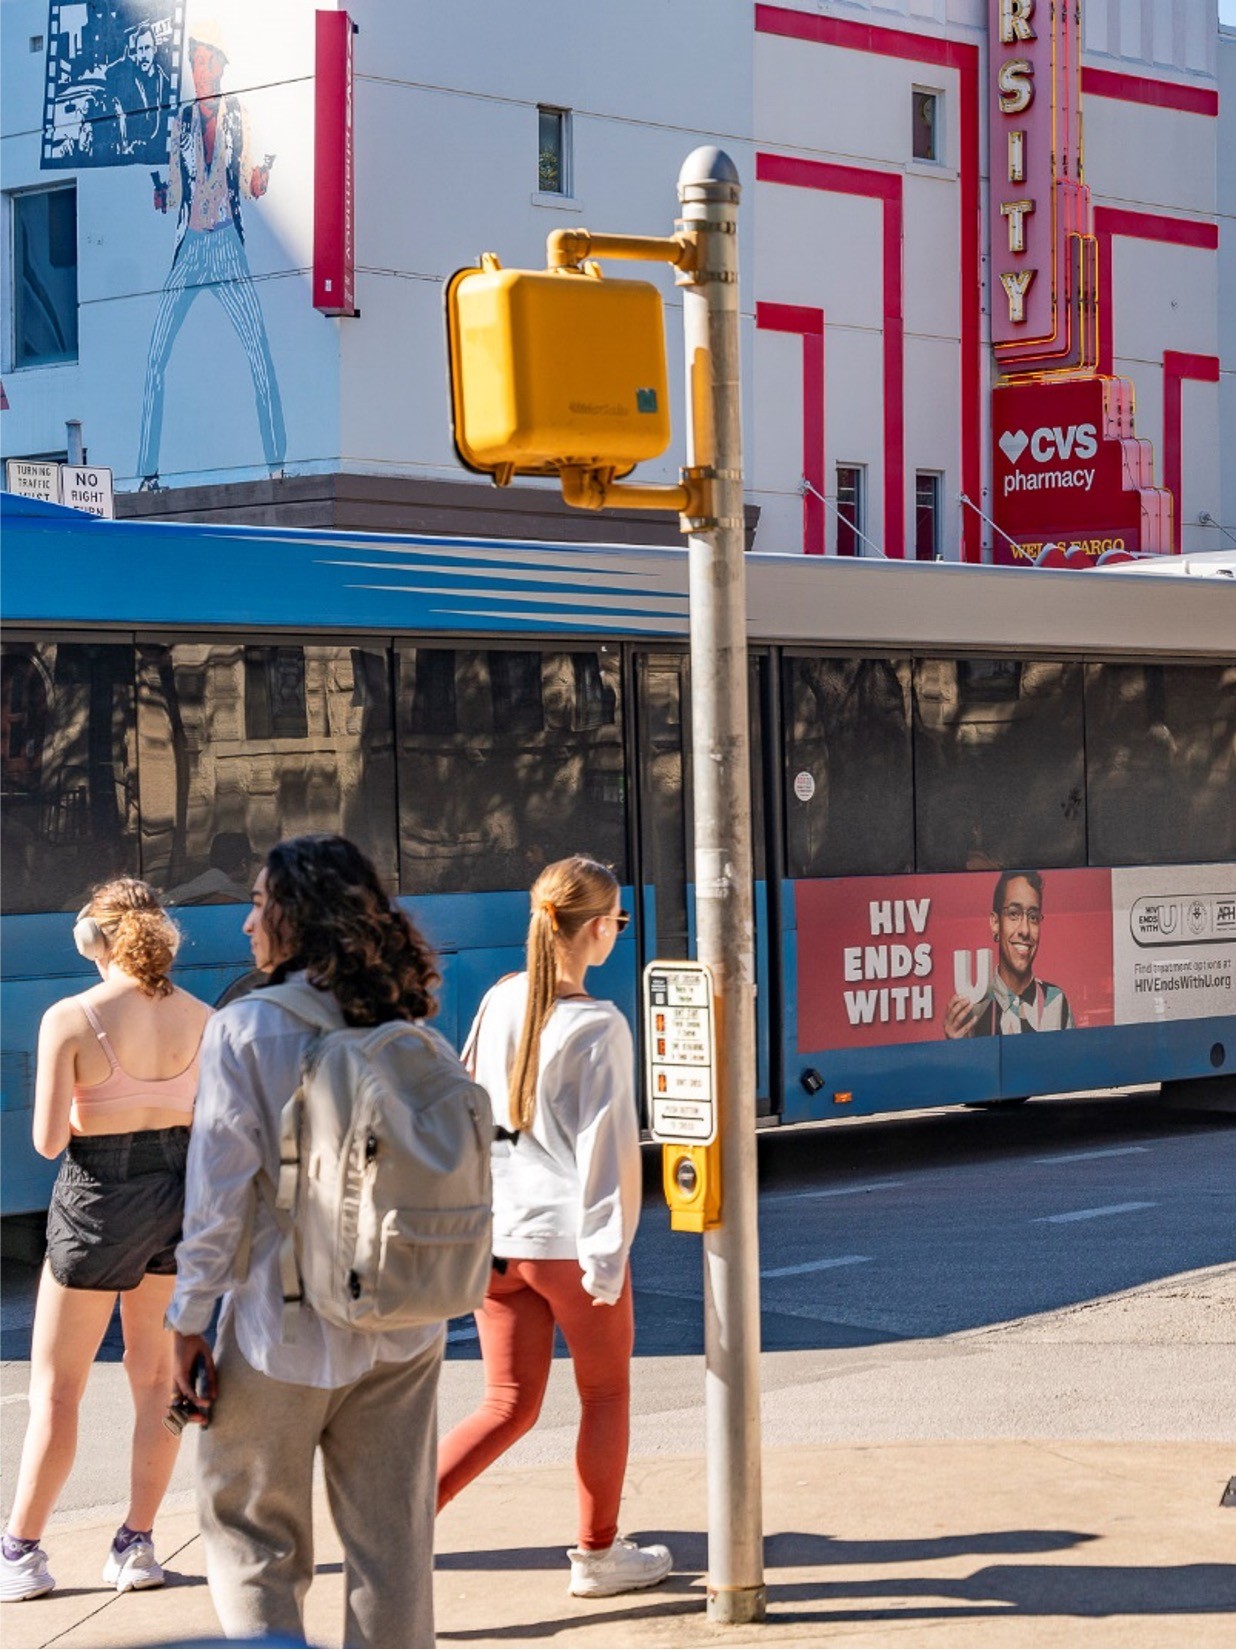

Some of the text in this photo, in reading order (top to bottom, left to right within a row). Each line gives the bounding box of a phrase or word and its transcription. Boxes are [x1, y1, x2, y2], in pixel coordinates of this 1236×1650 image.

[1031, 423, 1097, 463] CVS
[17, 465, 51, 476] TURNING
[18, 478, 50, 489] TRAFFIC
[76, 472, 98, 487] NO
[1004, 469, 1096, 497] pharmacy
[71, 490, 104, 503] RIGHT
[869, 898, 931, 936] HIV
[1145, 906, 1158, 914] HIV
[1217, 906, 1235, 920] APH
[1139, 915, 1158, 923] ENDS
[1158, 905, 1177, 935] U
[1140, 925, 1158, 933] WITH
[844, 943, 932, 982] ENDS
[1134, 963, 1152, 974] Find
[1193, 959, 1221, 972] options
[953, 948, 993, 1005] U
[1134, 974, 1231, 992] HIVEndsWithU.org
[844, 985, 933, 1025] WITH
